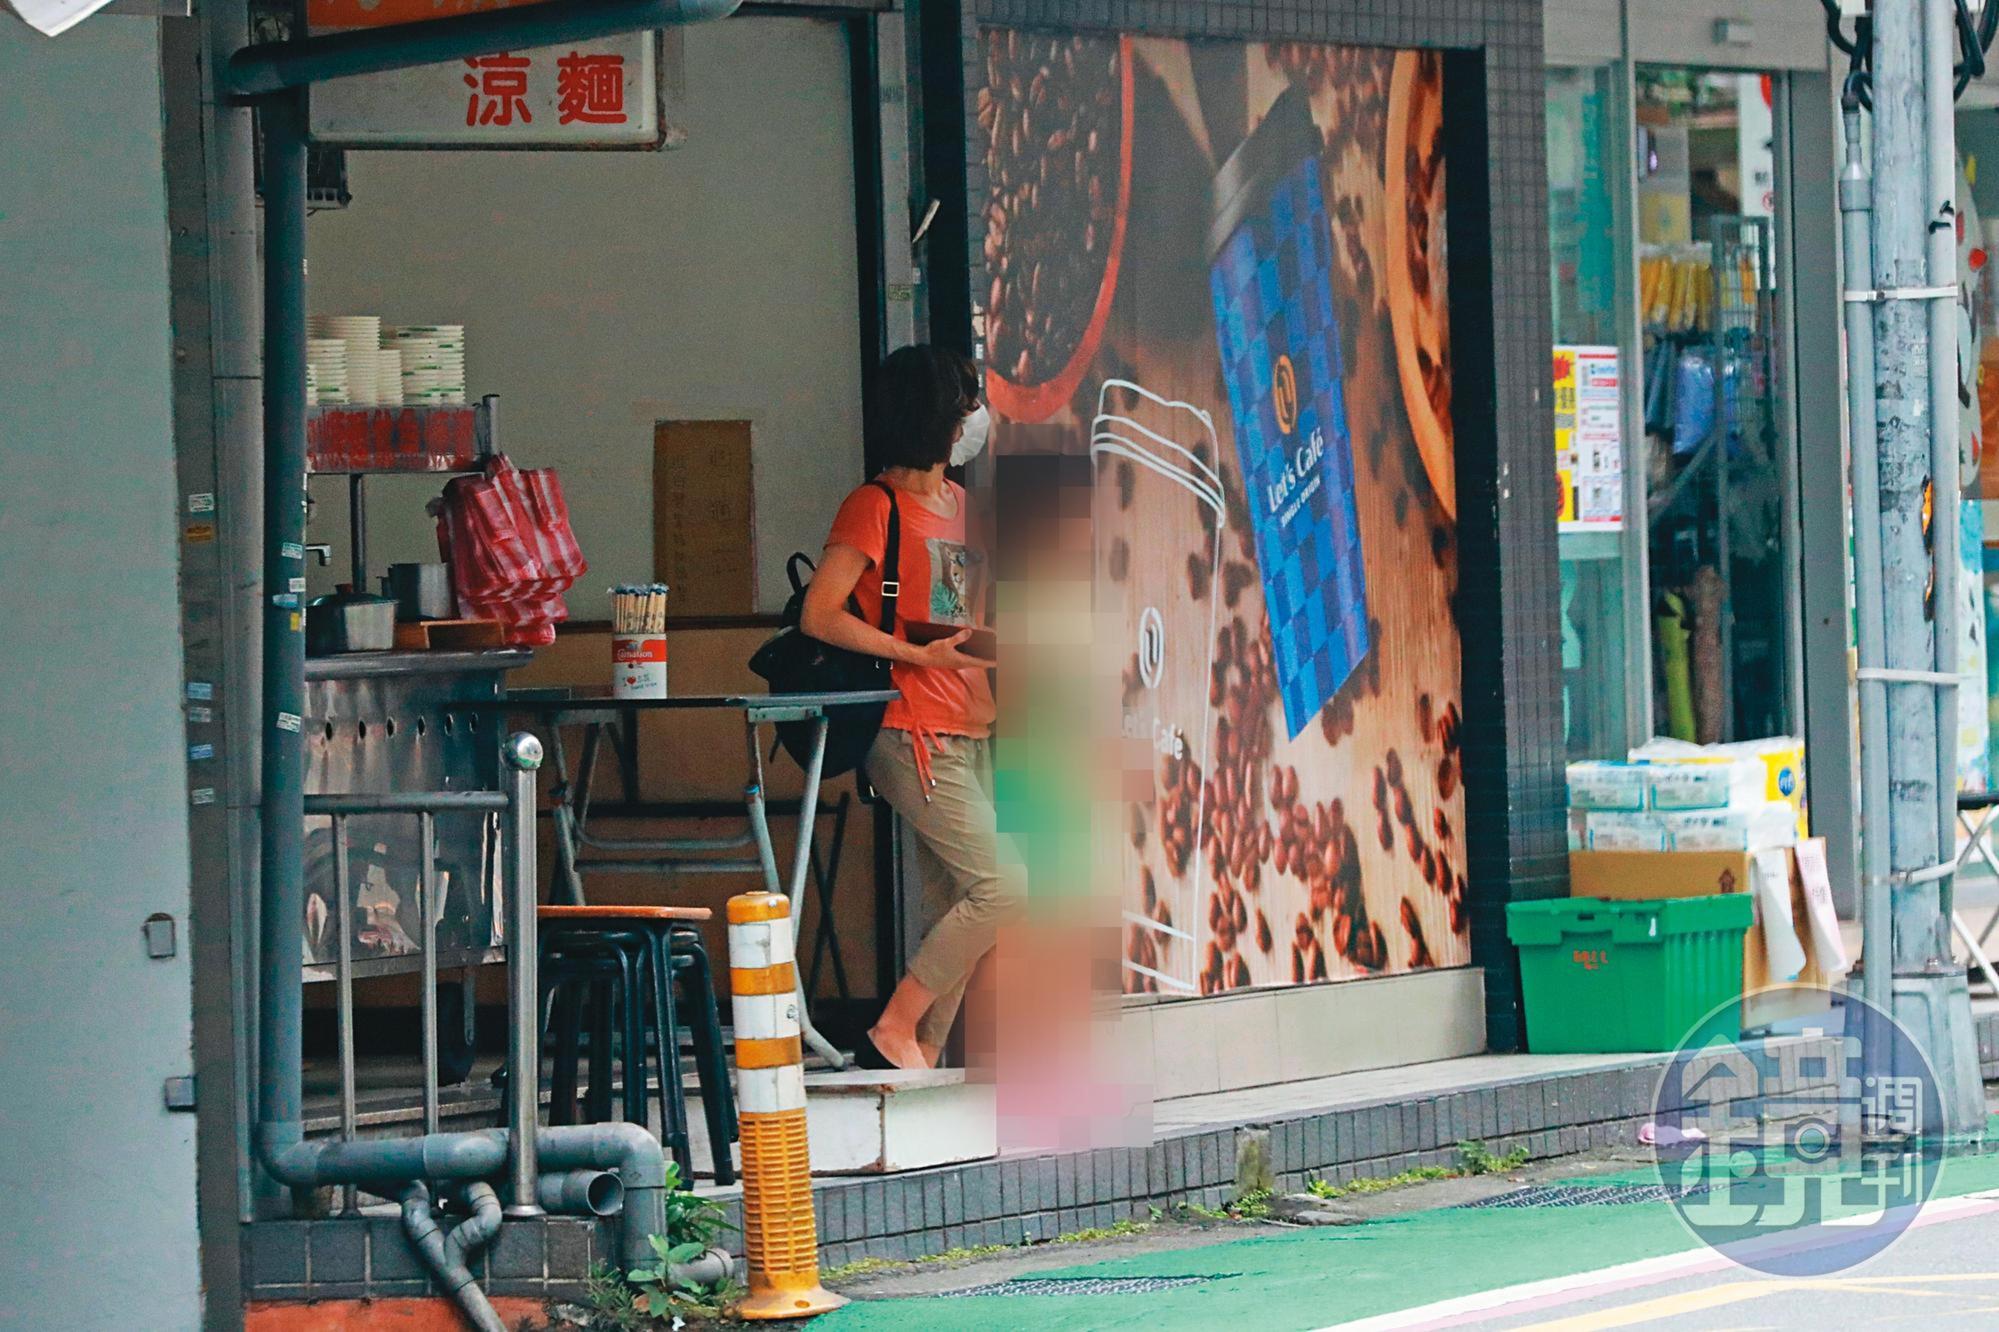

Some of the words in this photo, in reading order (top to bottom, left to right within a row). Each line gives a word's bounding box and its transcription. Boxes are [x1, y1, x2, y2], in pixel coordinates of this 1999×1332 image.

[463, 51, 628, 127] 涼麵
[1267, 462, 1296, 513] Let's
[1296, 426, 1324, 477] Café
